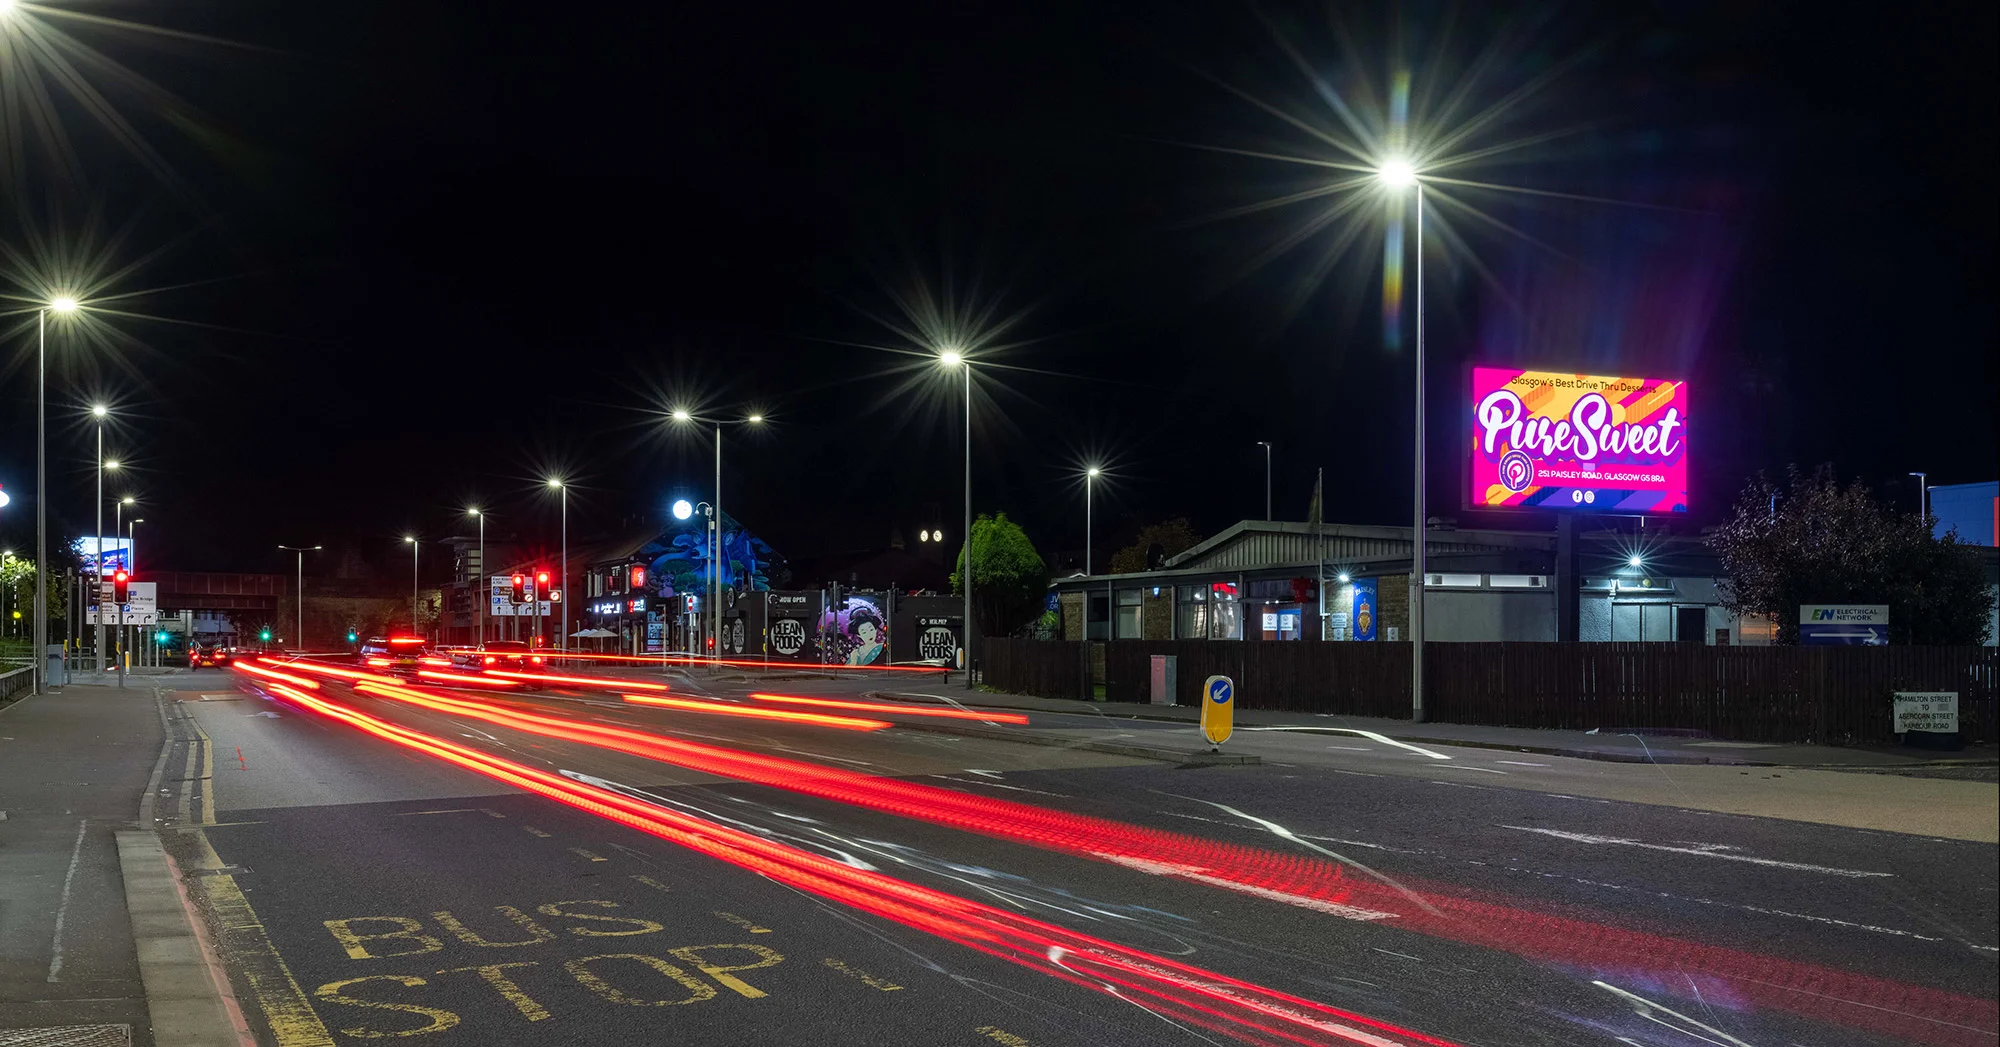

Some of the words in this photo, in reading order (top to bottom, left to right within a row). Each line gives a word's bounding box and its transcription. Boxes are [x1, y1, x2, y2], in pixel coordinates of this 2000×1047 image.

[1511, 376, 1554, 389] Glasgow's
[1555, 379, 1575, 388] Best
[1576, 380, 1598, 390] Drive
[1600, 381, 1619, 391] Thru
[1620, 383, 1656, 394] Desserts
[1538, 469, 1551, 478] 251
[1551, 470, 1580, 479] PAISLEY
[1604, 472, 1640, 482] GLASGOW
[1640, 474, 1651, 482] G5
[1651, 475, 1665, 483] 8RA
[1354, 586, 1375, 597] PAISLEY
[1811, 609, 1835, 621] EN
[774, 622, 802, 635] CLEAN
[775, 636, 803, 650] FOODS
[923, 632, 953, 645] CLEAN
[922, 646, 953, 659] FOODS
[323, 900, 663, 960] BUS
[314, 943, 786, 1039] STOP
